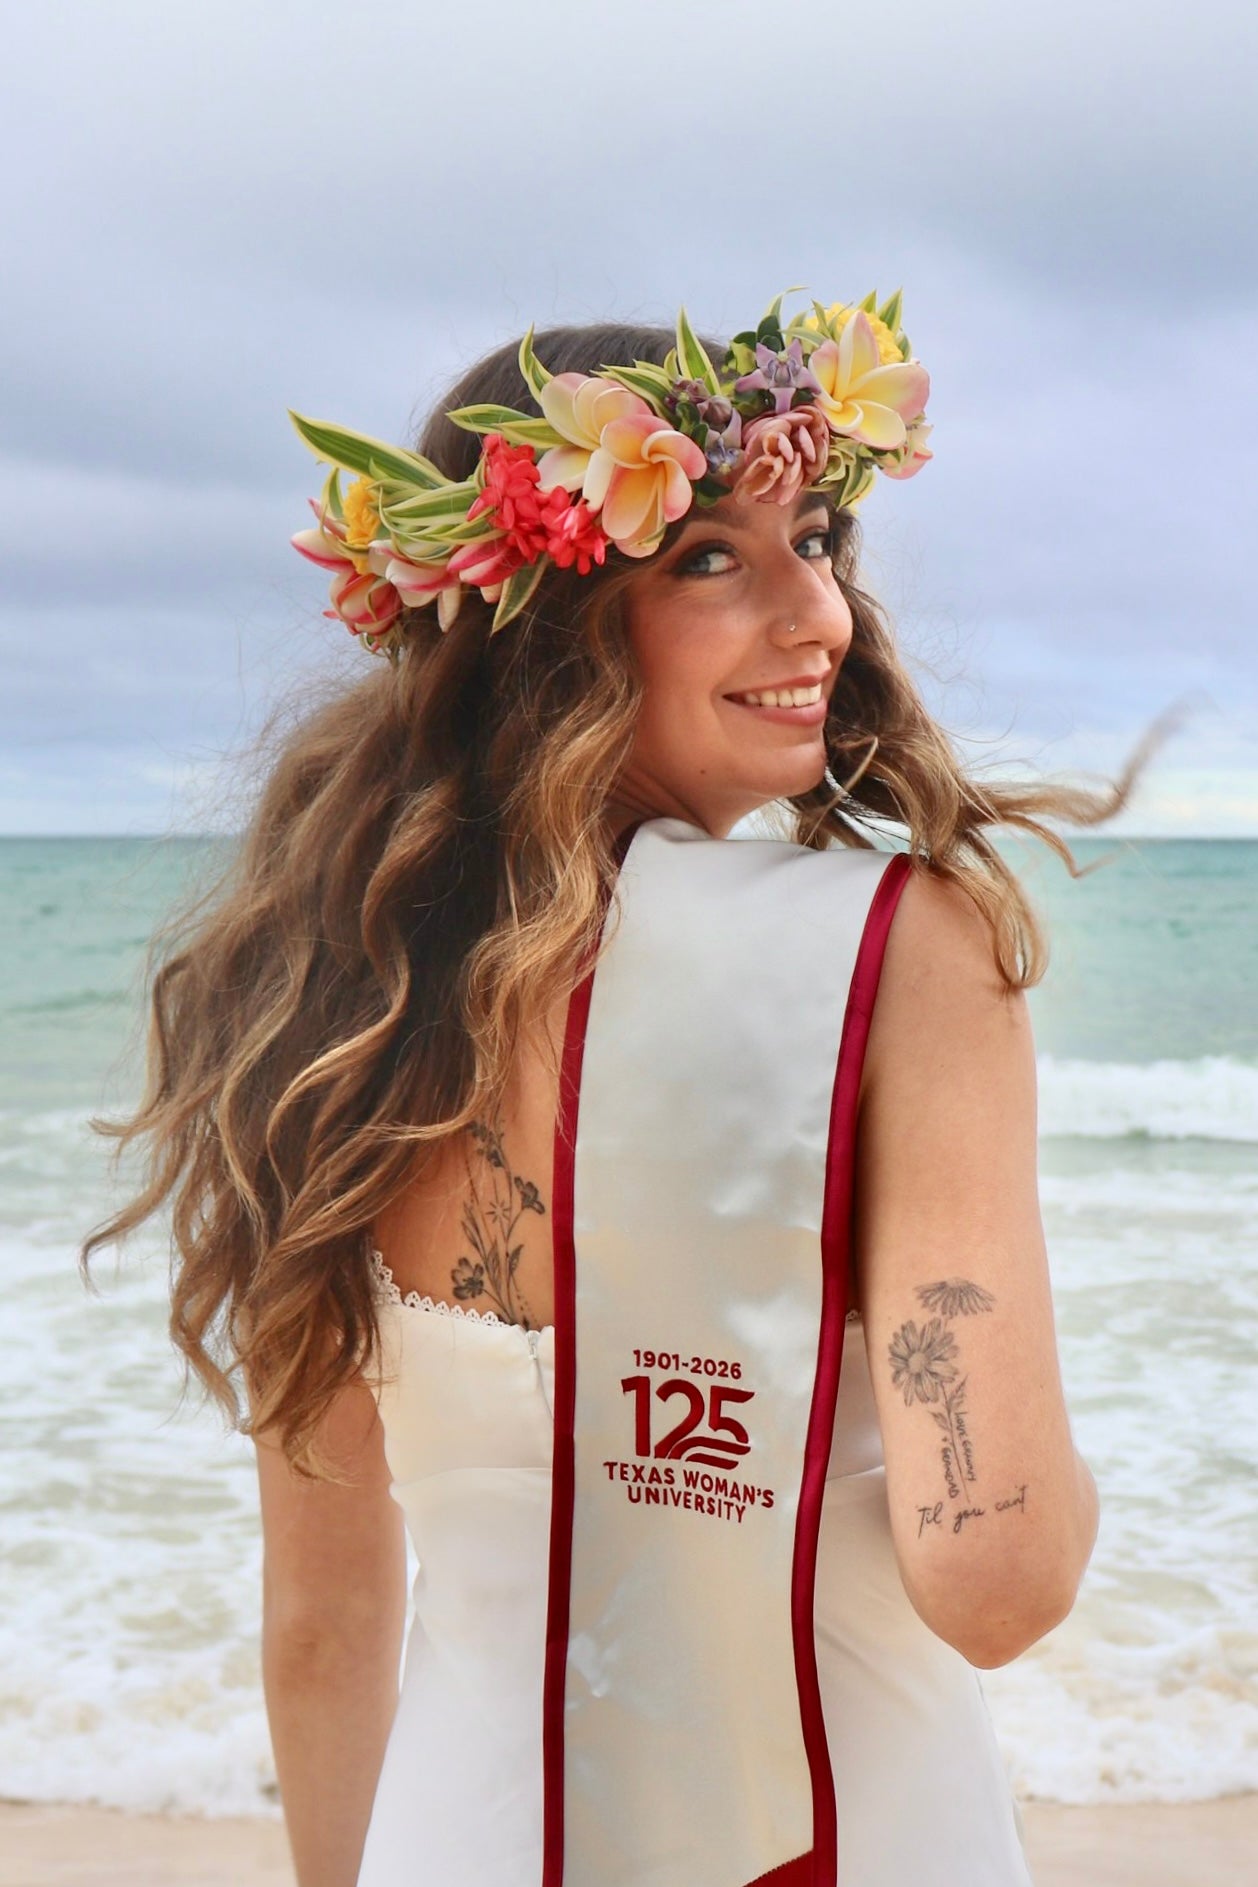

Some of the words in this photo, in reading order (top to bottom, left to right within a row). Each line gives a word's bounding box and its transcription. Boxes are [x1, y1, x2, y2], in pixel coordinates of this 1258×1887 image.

[633, 1349, 742, 1380] 1901-2026
[621, 1376, 755, 1470] 125
[603, 1461, 675, 1485] TEXAS
[683, 1469, 774, 1508] WOMAN'S
[627, 1485, 746, 1523] UNIVERSITY
[953, 1508, 985, 1533] you
